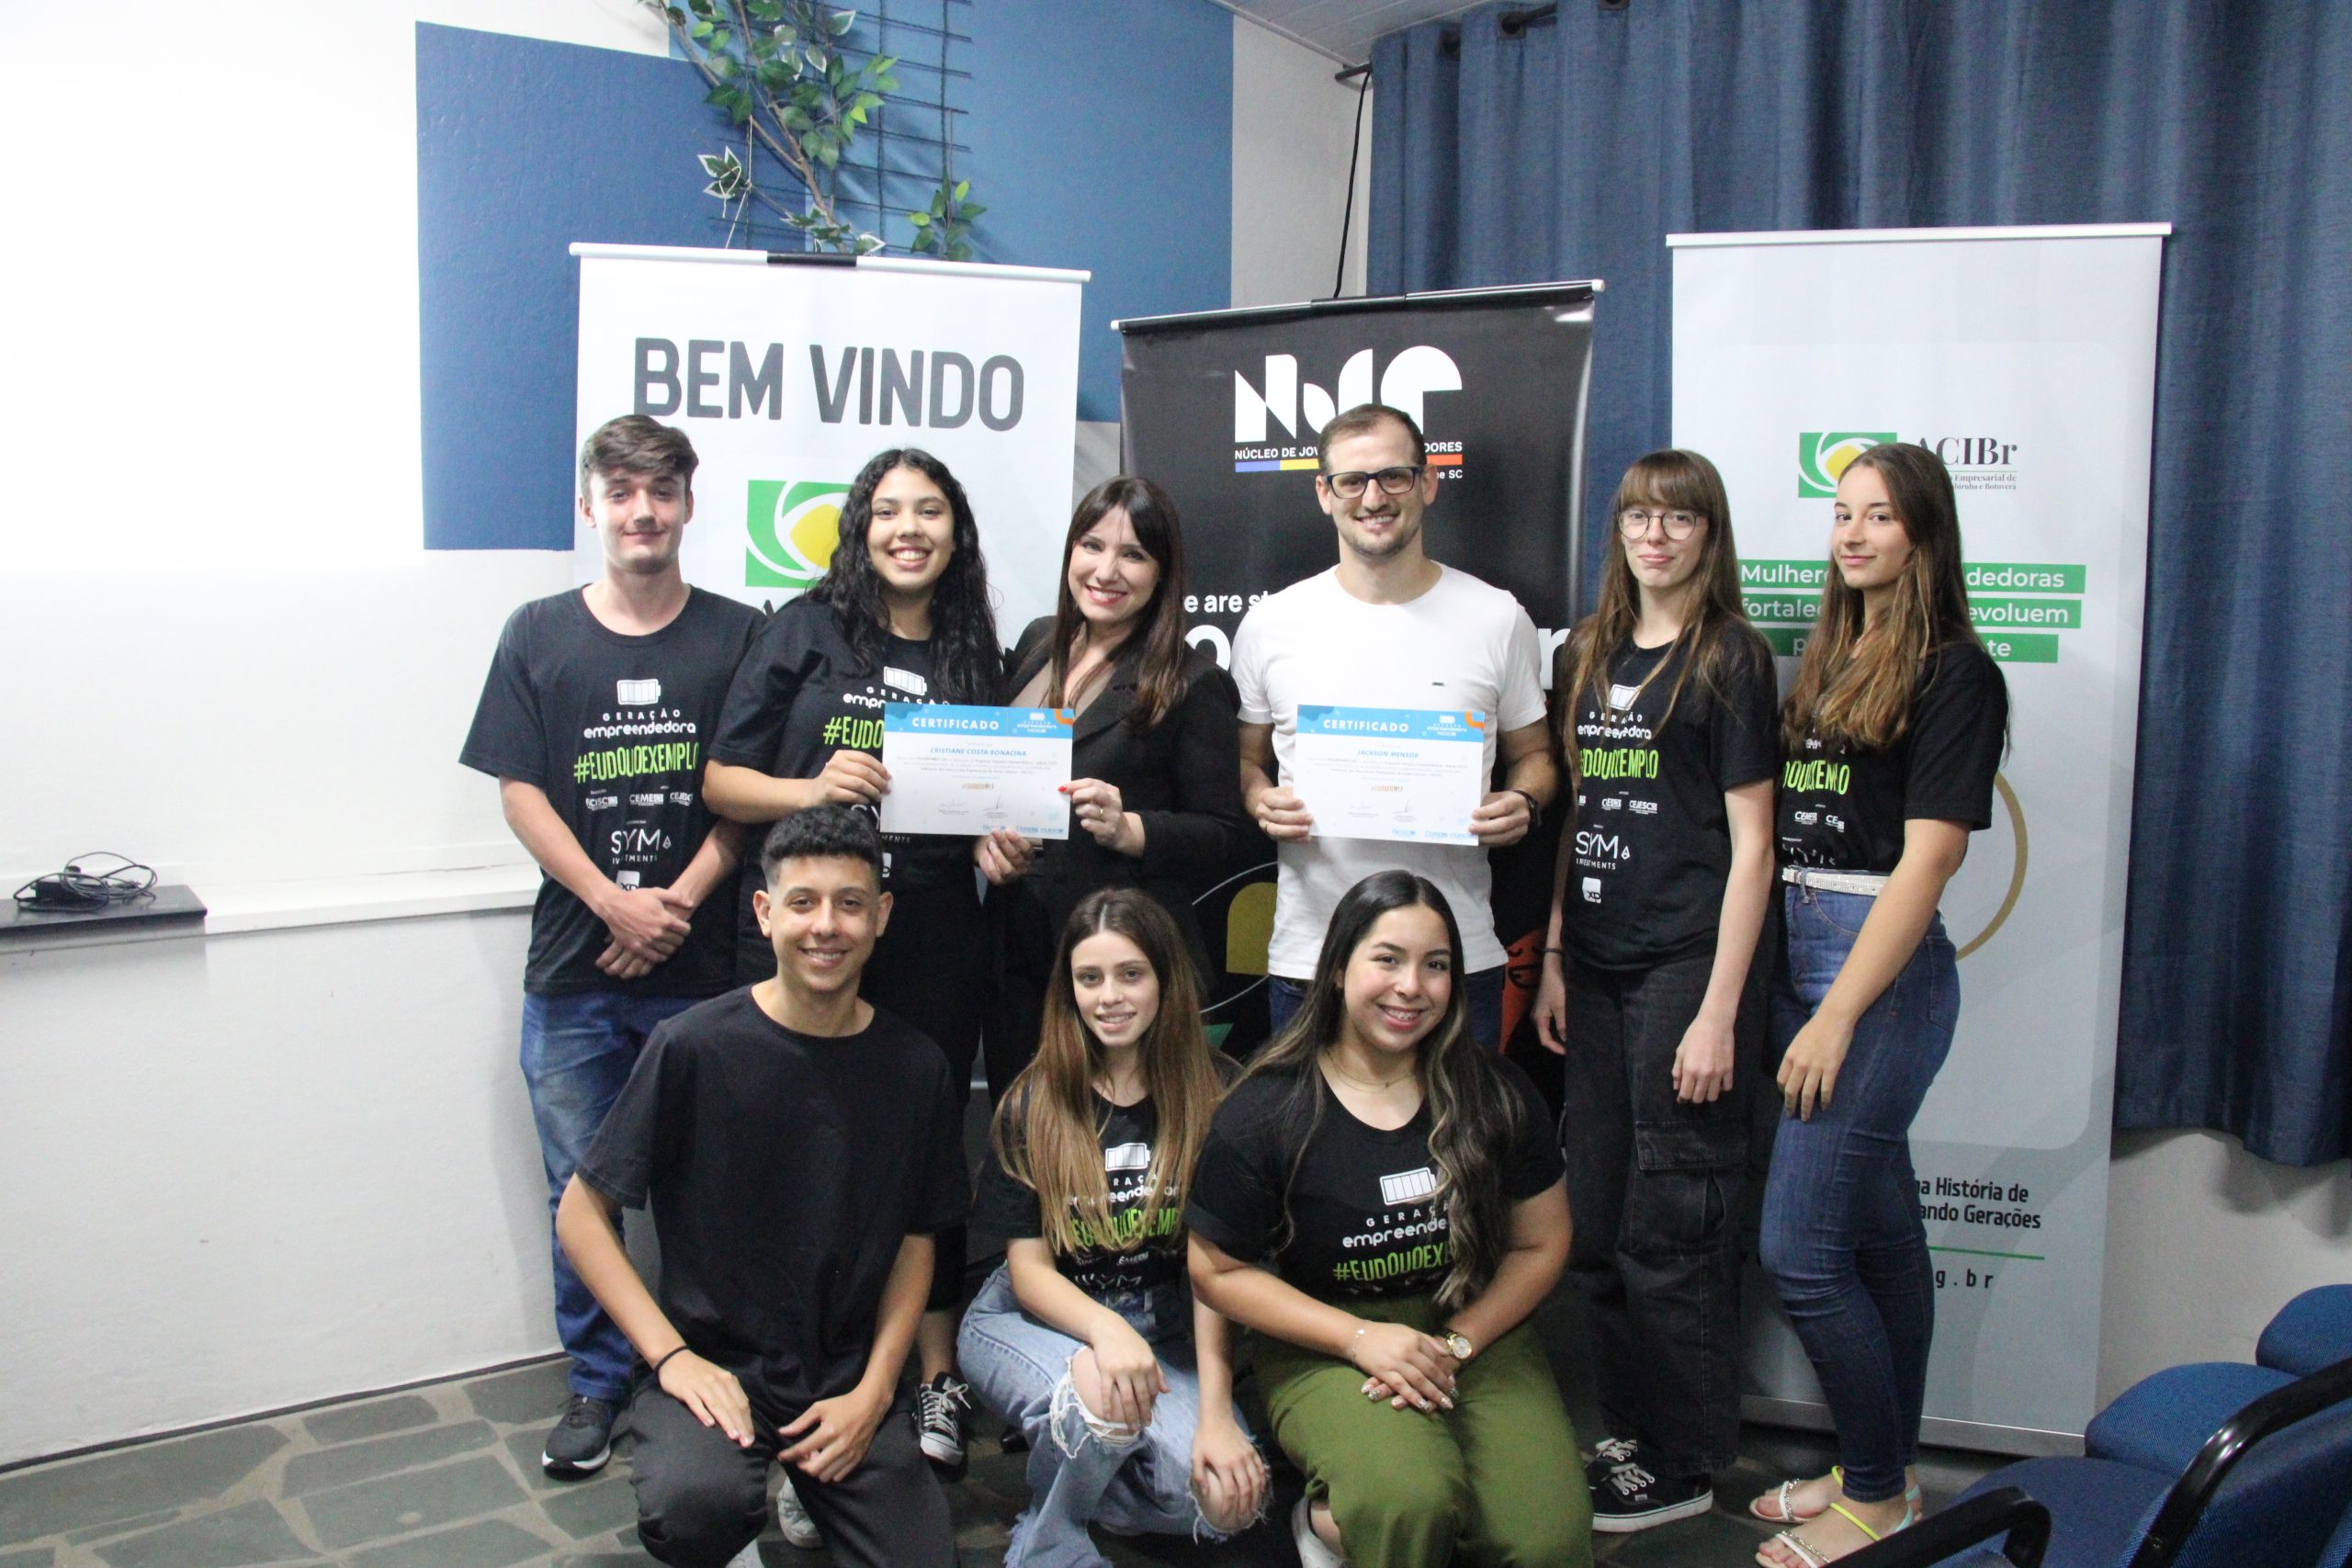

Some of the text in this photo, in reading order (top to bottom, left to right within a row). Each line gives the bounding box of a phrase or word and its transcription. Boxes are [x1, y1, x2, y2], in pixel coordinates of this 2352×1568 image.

[634, 337, 1024, 432] BEM VINDO
[1235, 446, 1278, 459] NÚCLEO
[1282, 446, 1296, 457] DE
[1449, 469, 1463, 479] SC
[1955, 474, 2004, 482] Empresarial
[1966, 567, 2064, 587] dedoras
[1204, 595, 1242, 613] are
[583, 720, 695, 739] empreendedora
[823, 716, 885, 749] #EUDO
[912, 717, 999, 730] CERTIFICADO
[1323, 719, 1409, 733] CERTIFICADO
[611, 829, 661, 854] SYM
[1576, 831, 1619, 859] SYM
[1936, 1177, 2003, 1201] História
[2007, 1183, 2029, 1202] de
[1963, 1204, 2041, 1229] Gerações
[1342, 1218, 1448, 1247] empreende
